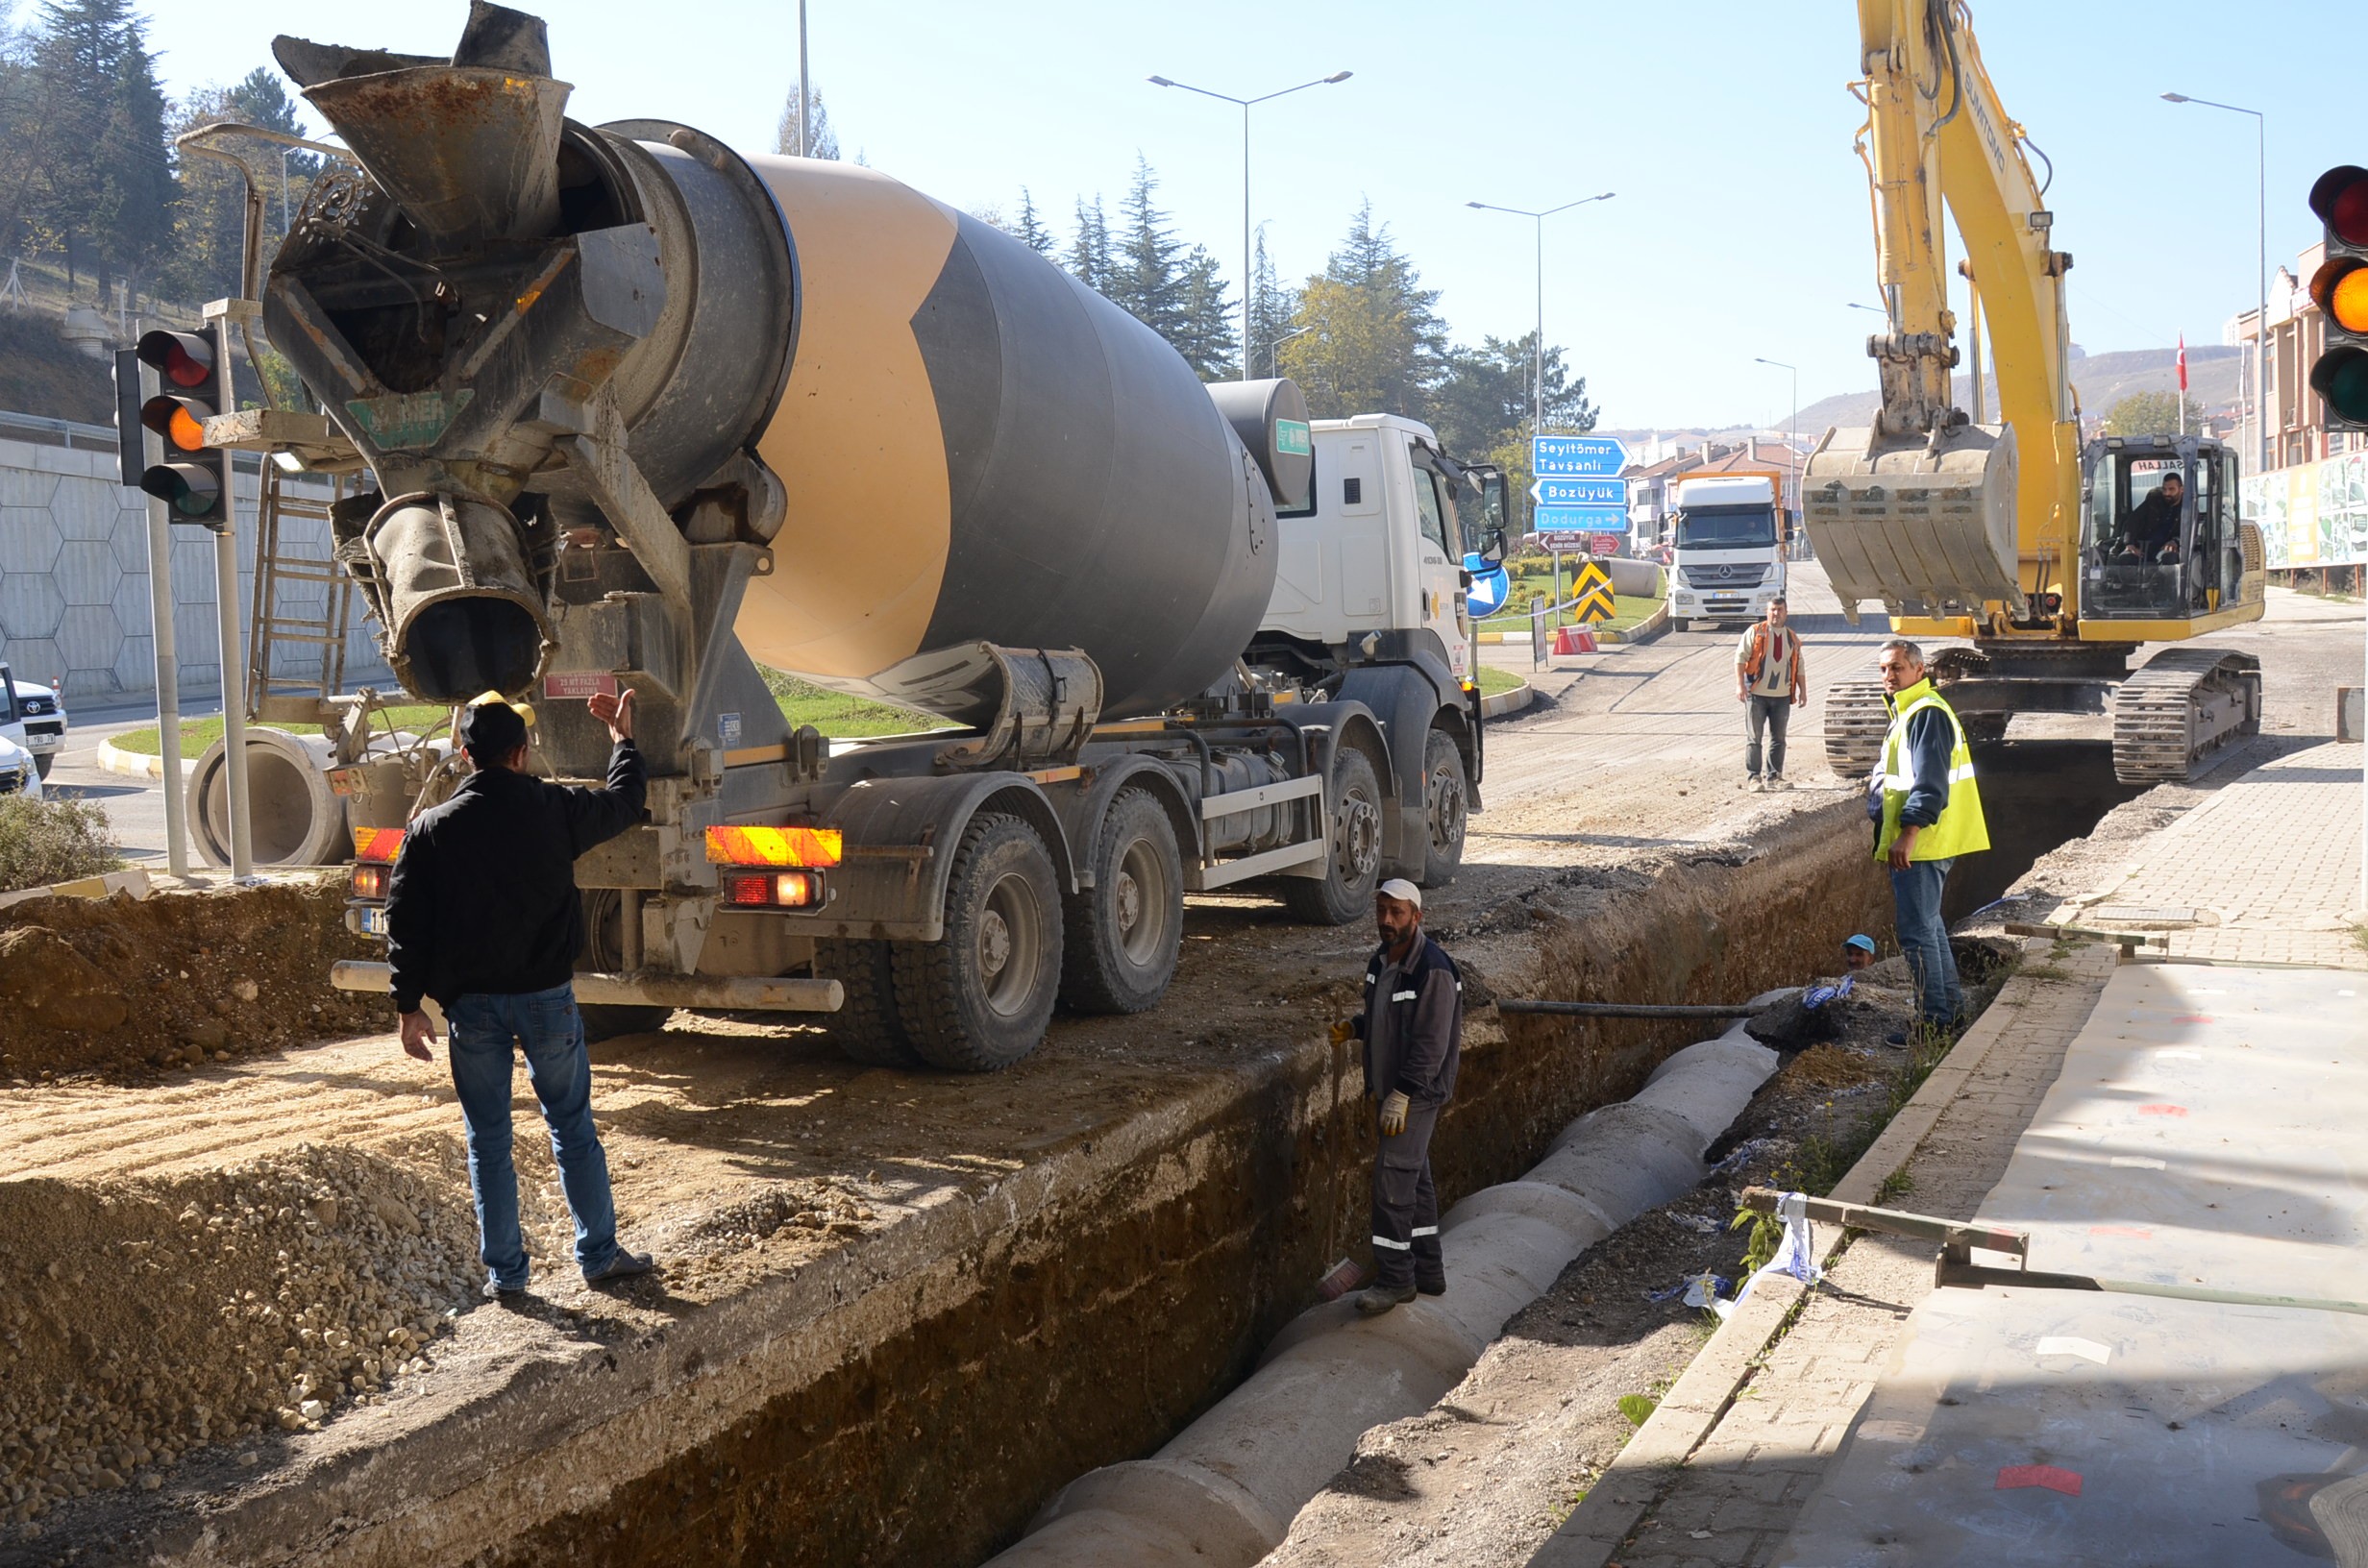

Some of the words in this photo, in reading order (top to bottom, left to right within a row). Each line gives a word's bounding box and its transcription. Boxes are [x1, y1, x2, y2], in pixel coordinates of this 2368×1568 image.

[1963, 71, 2006, 175] SUMITOMO
[1539, 441, 1612, 456] Seyitömer
[1540, 458, 1601, 472] Tavşanlı
[1548, 485, 1614, 501] Bozüyük
[1542, 513, 1602, 527] Dodurga
[580, 677, 601, 686] FAZLA
